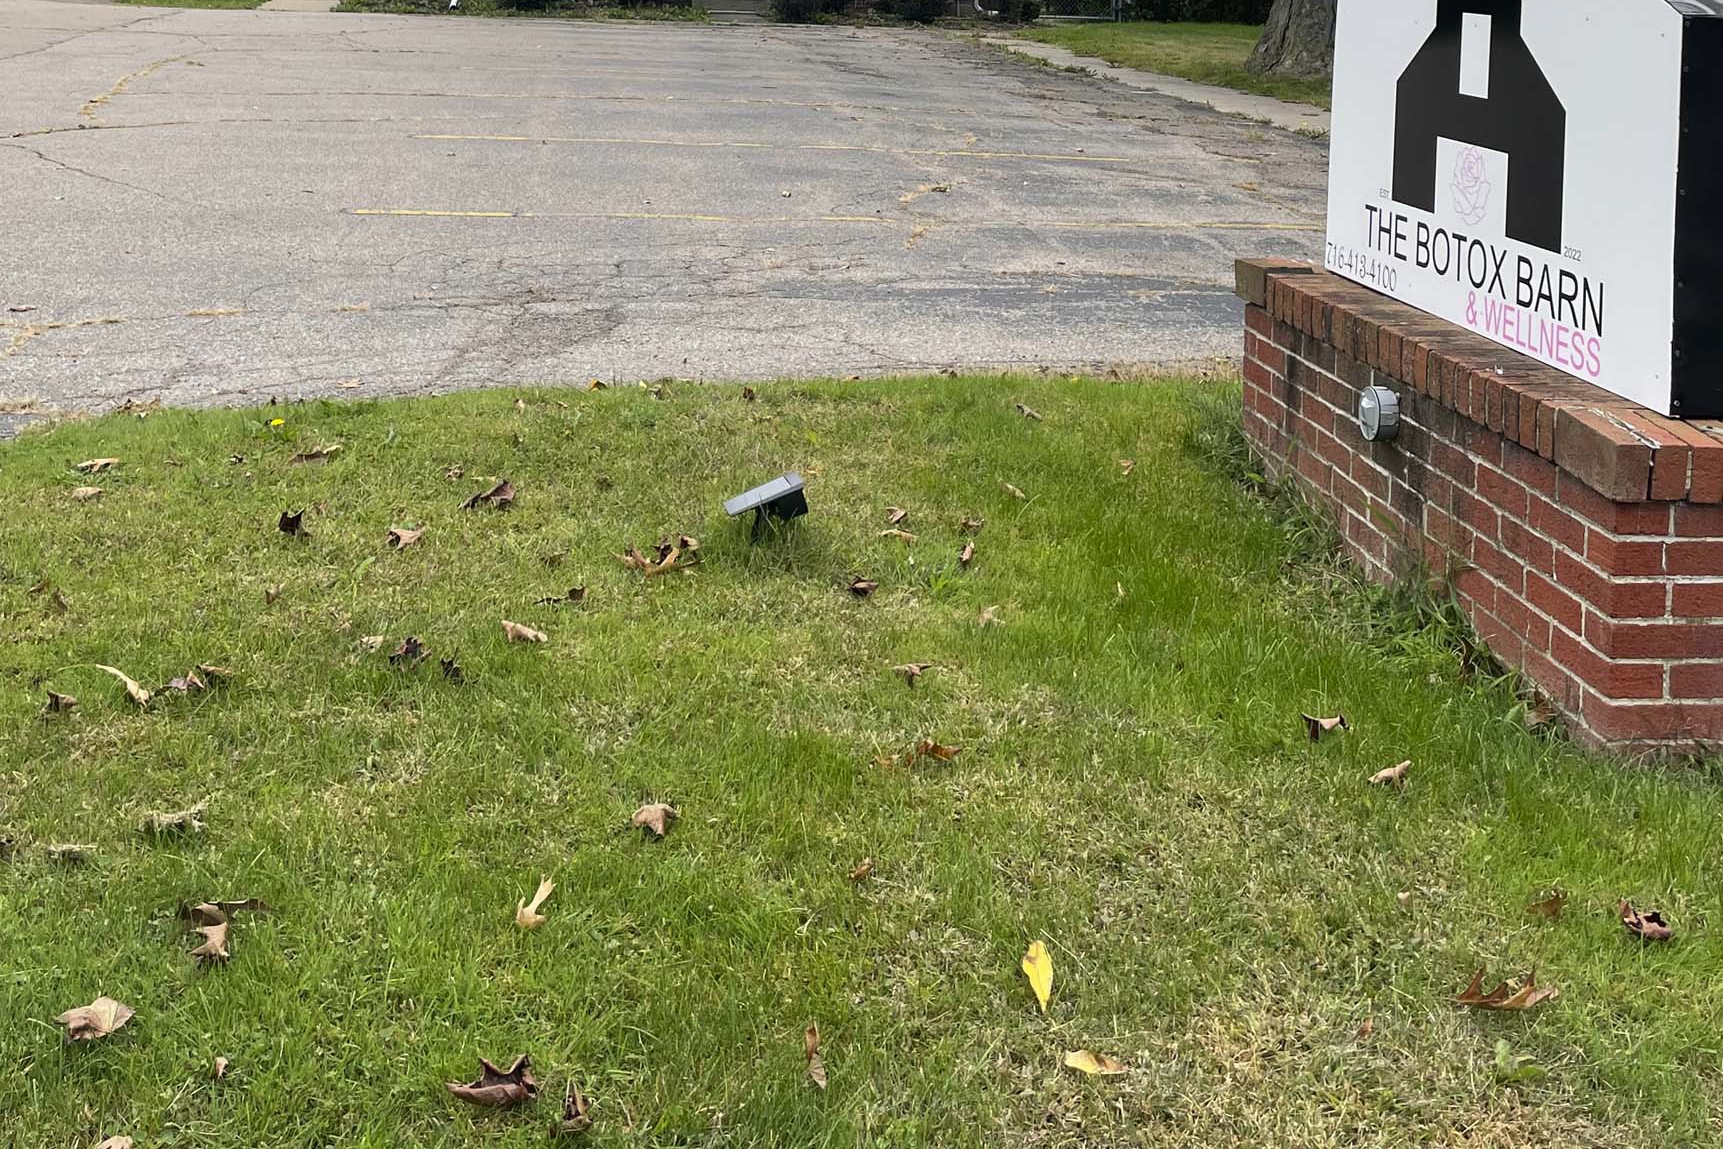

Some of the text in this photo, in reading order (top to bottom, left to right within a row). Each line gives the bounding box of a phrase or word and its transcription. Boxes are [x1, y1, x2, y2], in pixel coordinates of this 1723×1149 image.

[1327, 242, 1397, 291] 716-413-4100
[1365, 204, 1604, 337] THE BOTOX BARN
[1564, 246, 1582, 262] 2022
[1466, 290, 1601, 377] & WELLNESS
